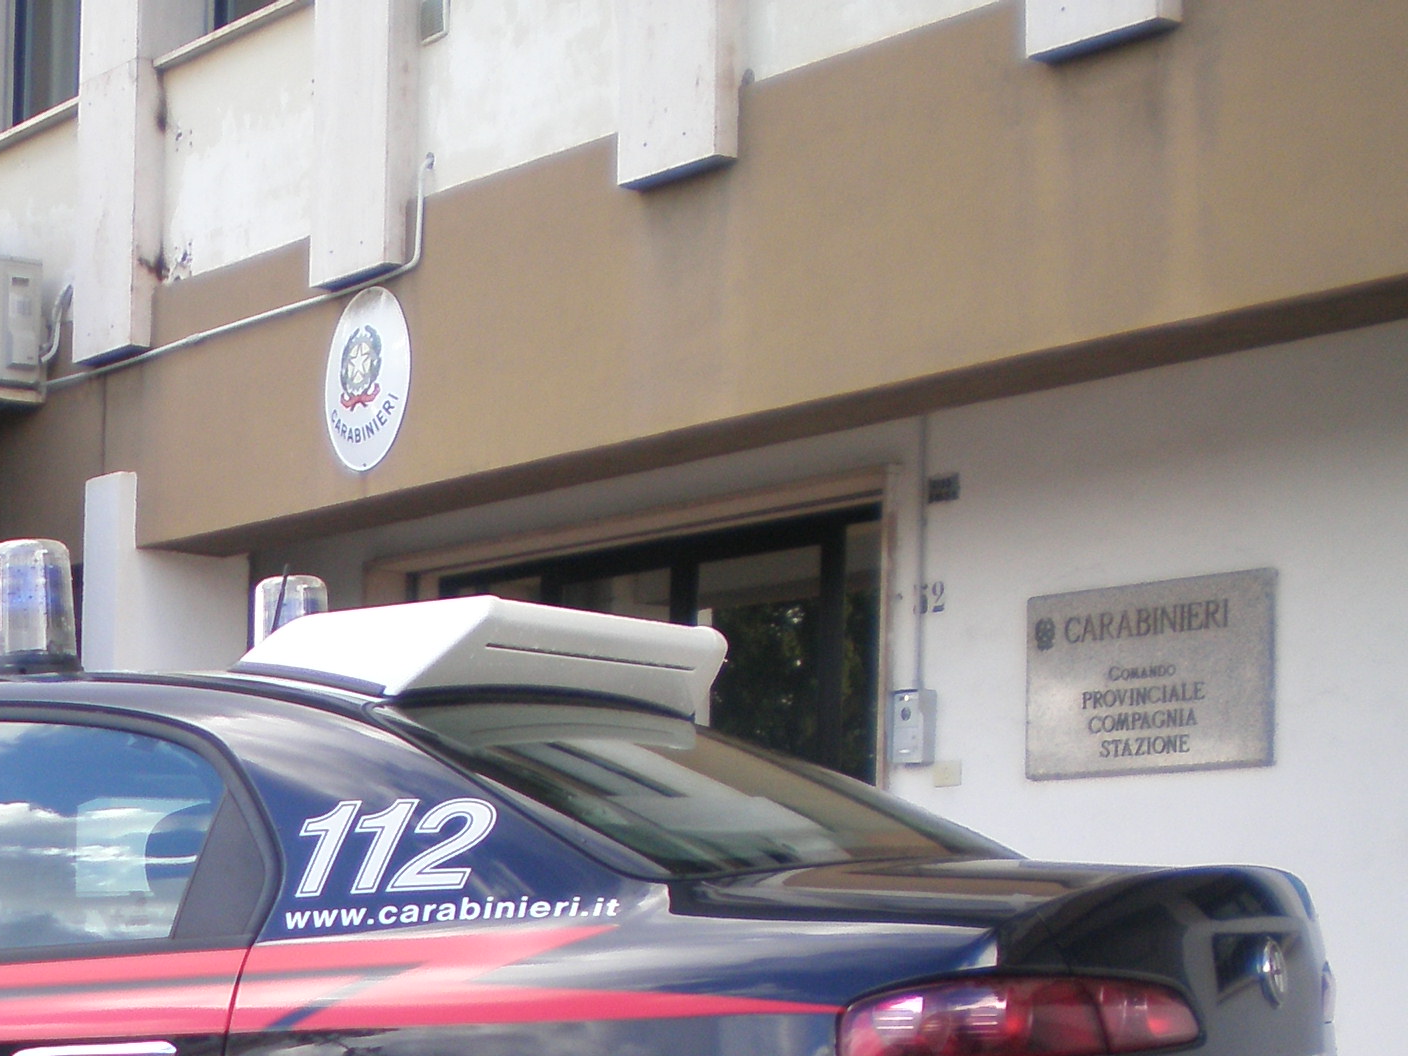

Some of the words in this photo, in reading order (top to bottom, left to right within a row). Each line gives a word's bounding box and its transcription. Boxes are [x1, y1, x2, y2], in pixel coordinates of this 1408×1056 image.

[330, 391, 400, 445] CARABINIERI
[1064, 598, 1230, 645] CARABINIERI
[1081, 681, 1206, 711] PROVINCIALE
[1087, 707, 1199, 735] COMPAGNIA
[1098, 733, 1191, 759] STAZIONE
[294, 796, 498, 899] 112
[284, 895, 621, 931] www.carabinieri.it
